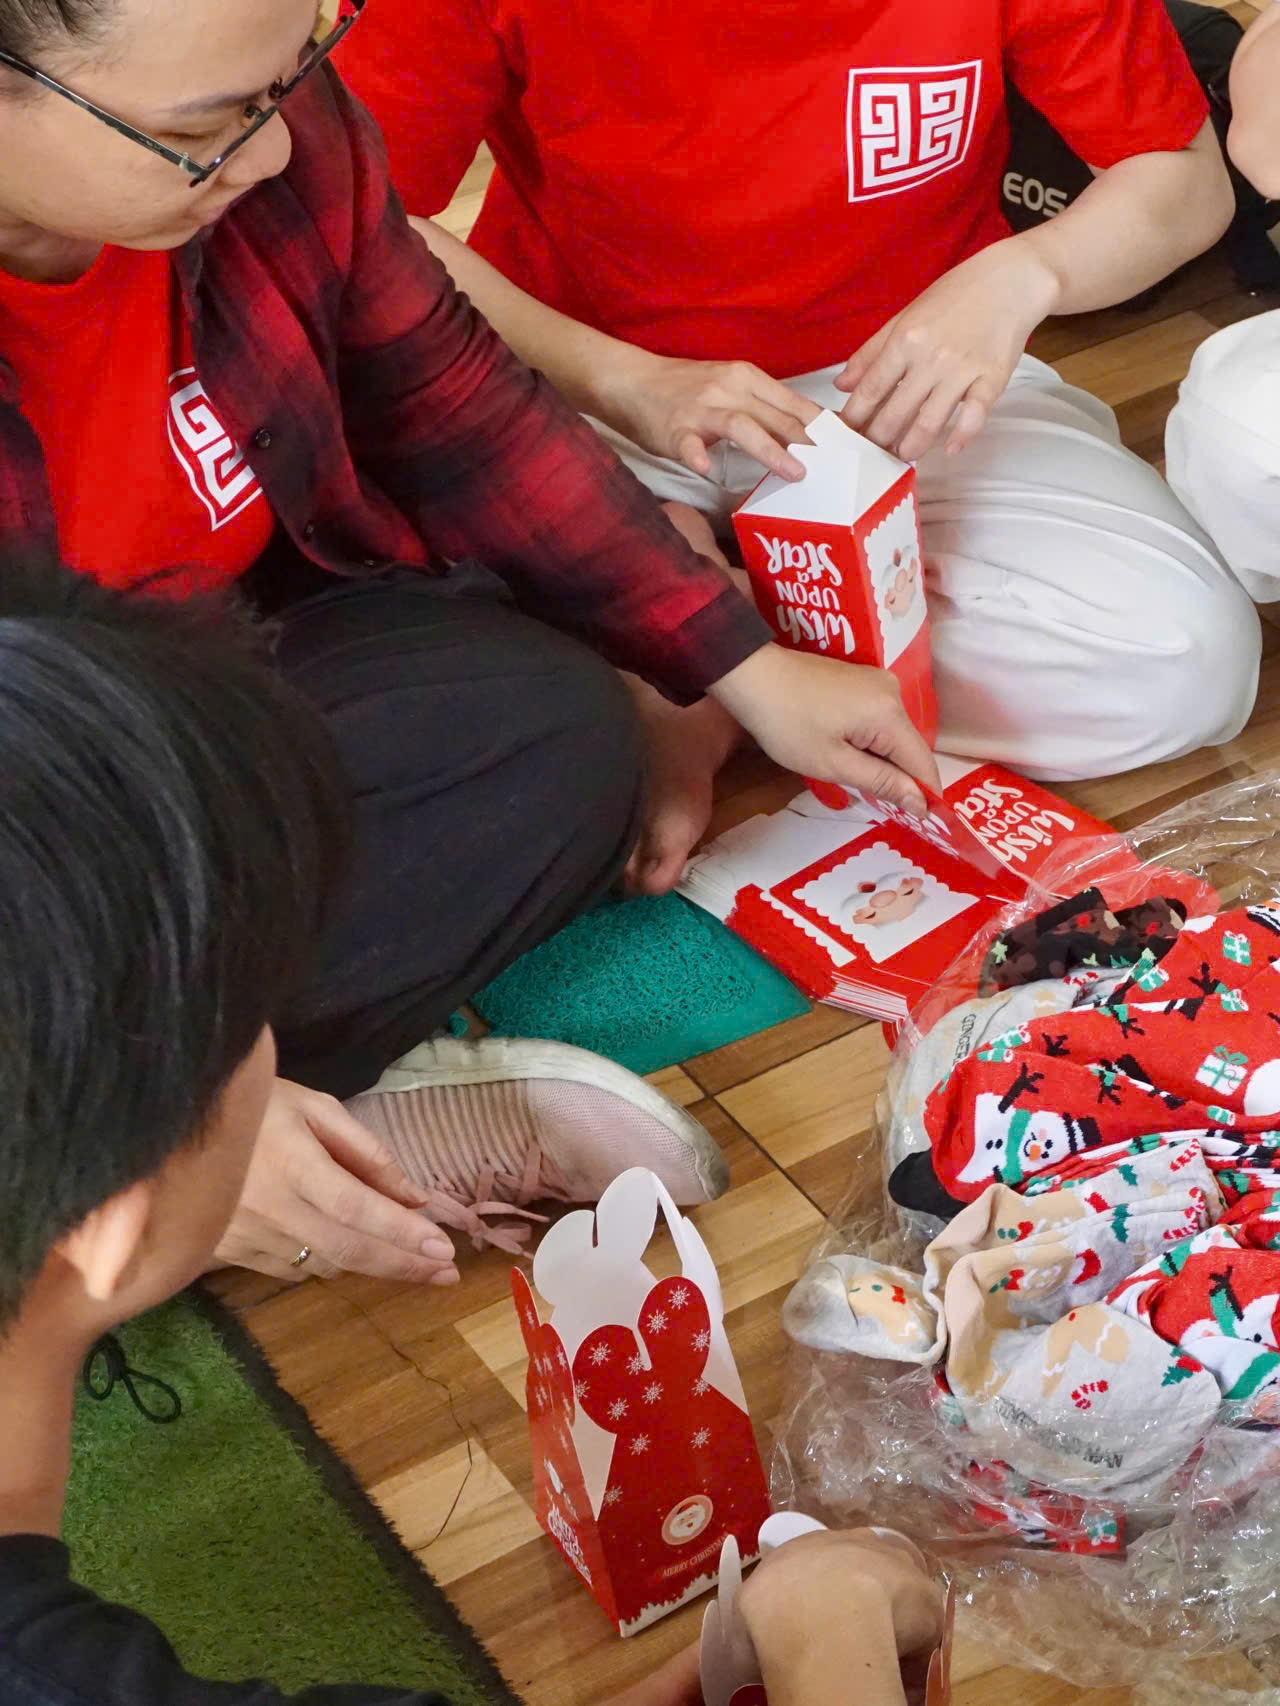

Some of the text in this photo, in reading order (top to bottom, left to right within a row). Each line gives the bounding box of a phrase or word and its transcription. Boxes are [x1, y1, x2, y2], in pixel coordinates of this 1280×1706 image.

[1003, 172, 1067, 217] EOS
[776, 580, 840, 610] UPON
[777, 604, 855, 655] Wish
[954, 779, 1023, 820] Sta
[978, 802, 1037, 844] UPON
